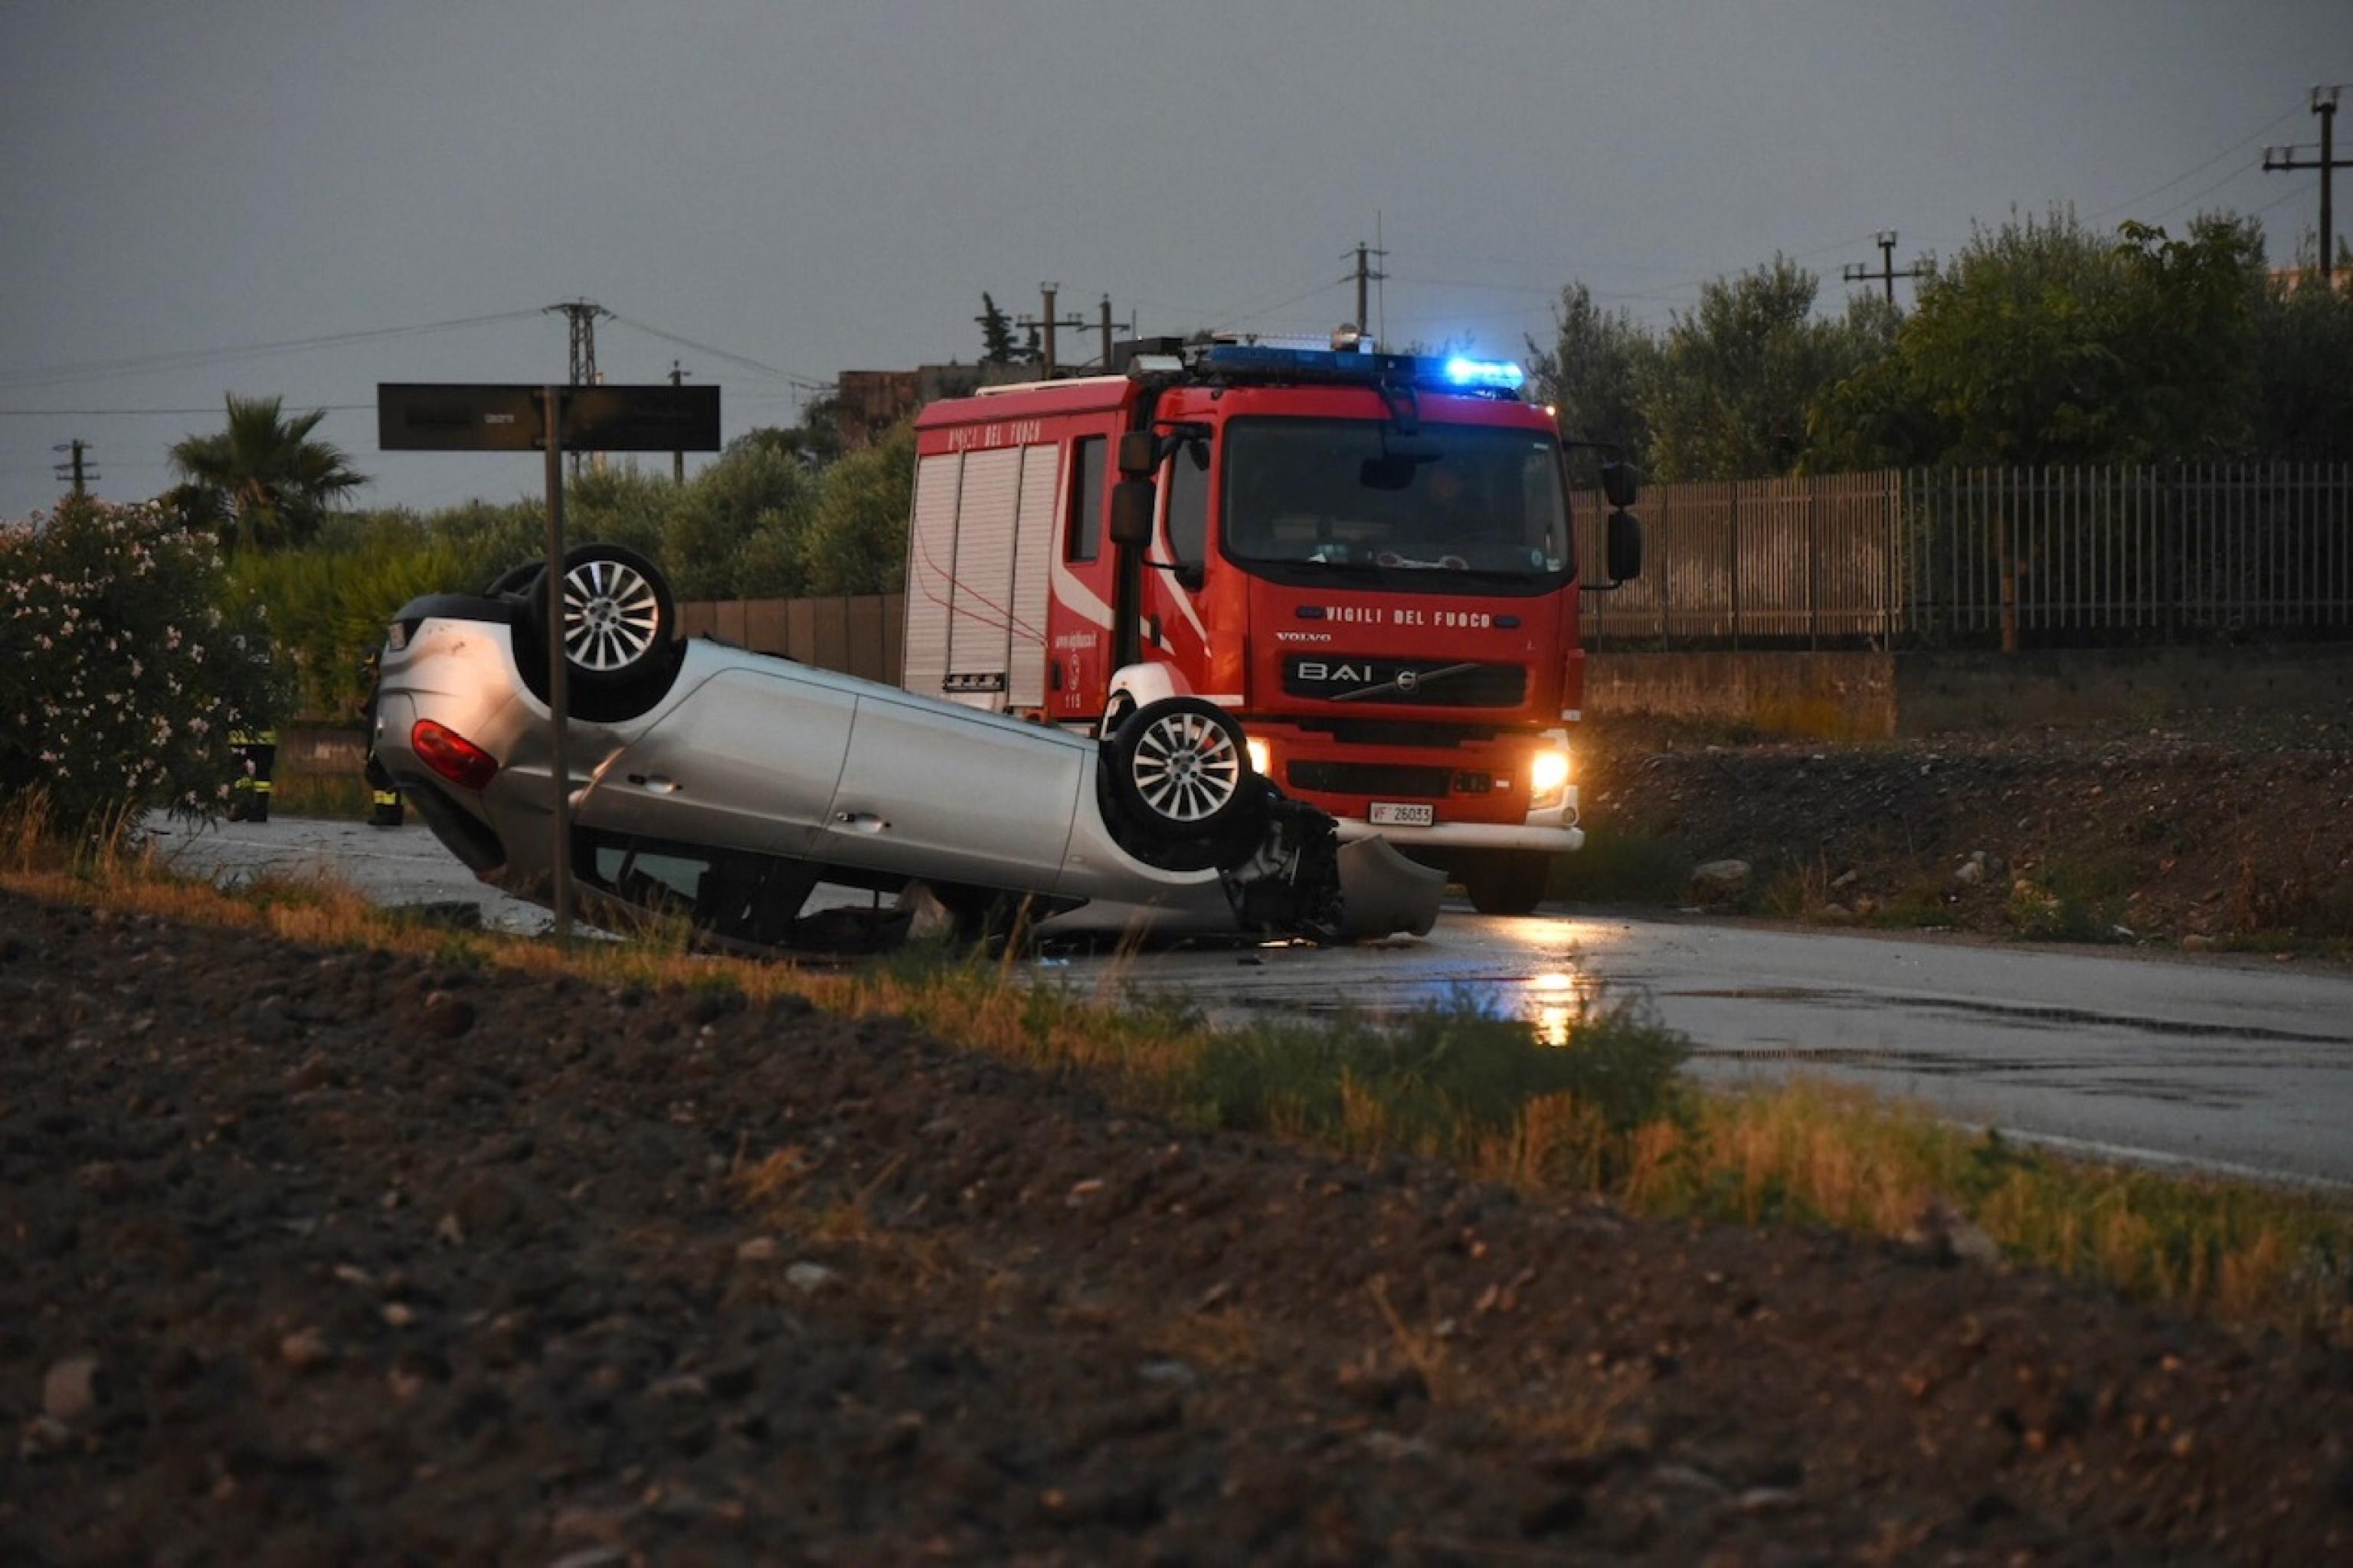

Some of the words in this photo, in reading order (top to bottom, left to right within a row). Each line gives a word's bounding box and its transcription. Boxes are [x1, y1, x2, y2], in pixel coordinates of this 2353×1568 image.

[1326, 606, 1382, 623] VIGILI
[1393, 610, 1425, 626] DEL
[1434, 612, 1491, 628] FUOCO
[1275, 631, 1332, 642] VOLVO
[1298, 662, 1372, 682] BAI
